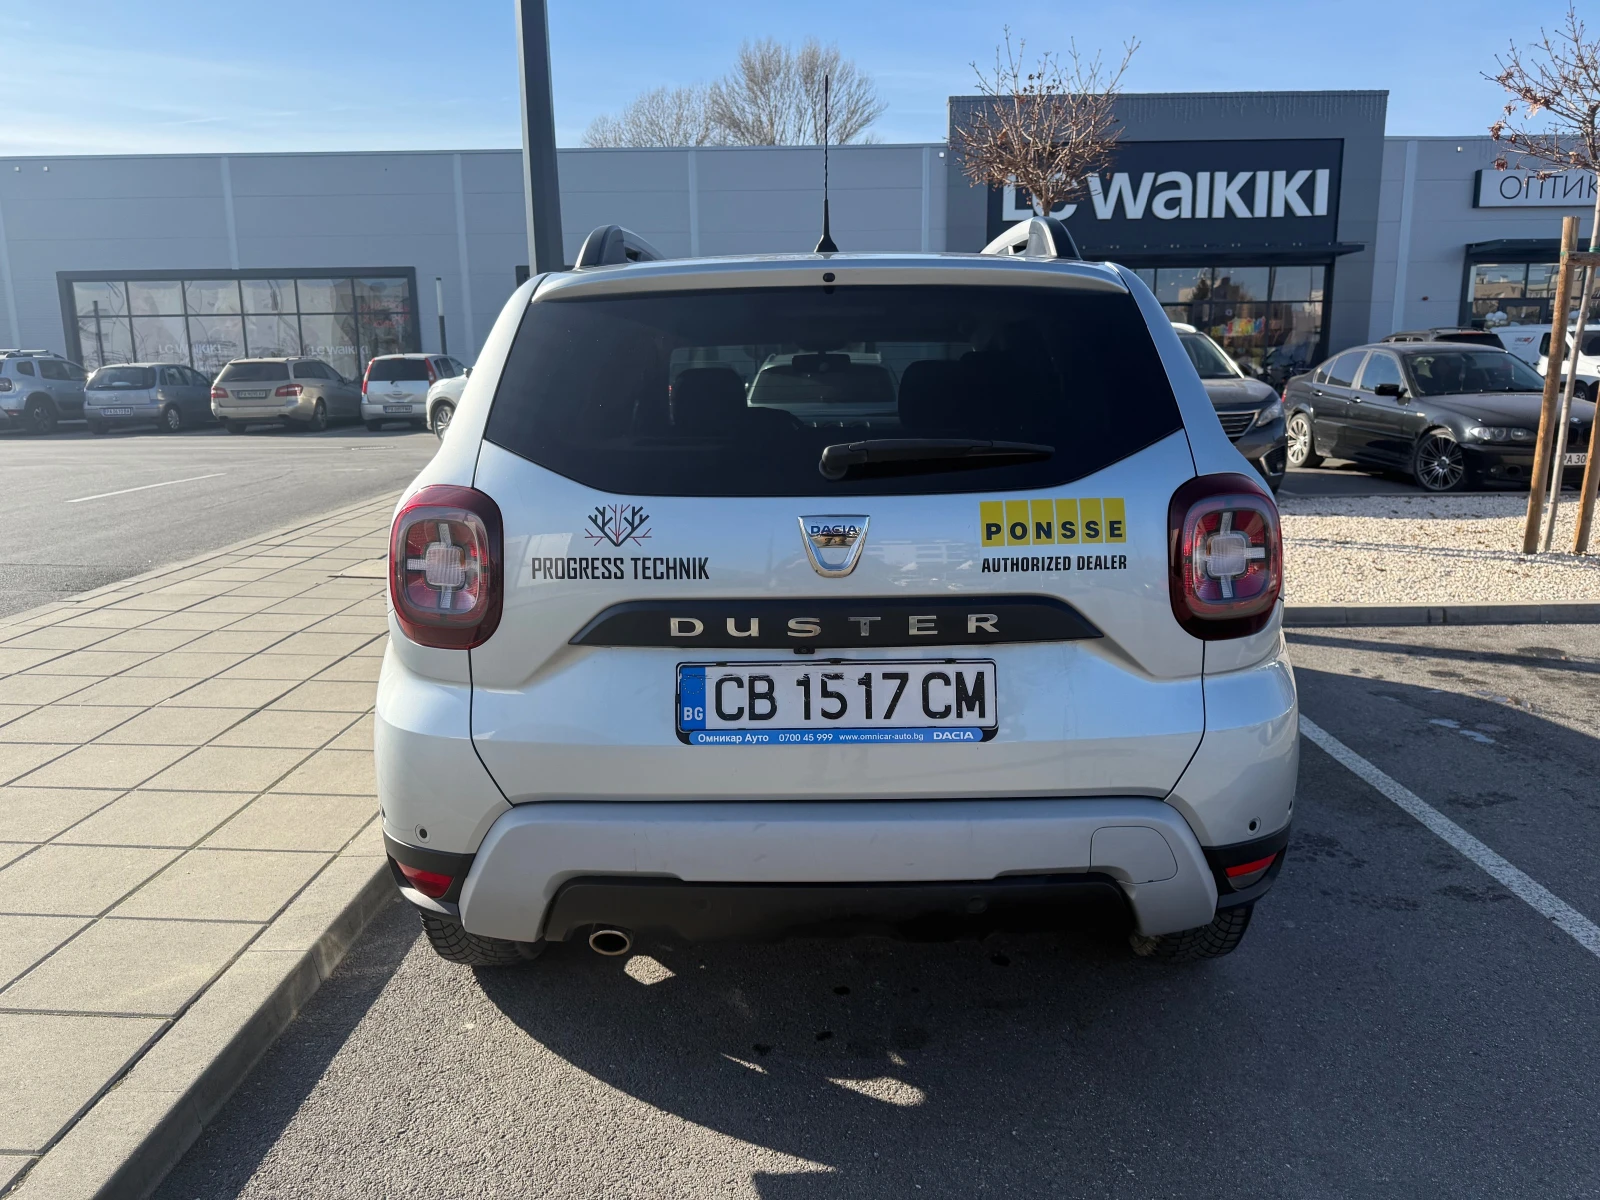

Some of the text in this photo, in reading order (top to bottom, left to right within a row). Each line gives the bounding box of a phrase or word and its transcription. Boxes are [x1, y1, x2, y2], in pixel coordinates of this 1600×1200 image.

[810, 525, 858, 535] DACIA
[985, 520, 1123, 541] PONSSE
[531, 557, 710, 580] PROGRESS TECHNIK
[981, 554, 1127, 573] AUTHORIZED DEALER
[670, 613, 1000, 638] DUSTER
[714, 671, 986, 721] CB 1517 CM
[683, 706, 704, 721] BG
[698, 733, 769, 744] Омникар Ауто
[778, 733, 833, 742] 0700 45 999
[838, 732, 924, 742] www.omnicar-auto.bg
[933, 731, 974, 740] DACIA
